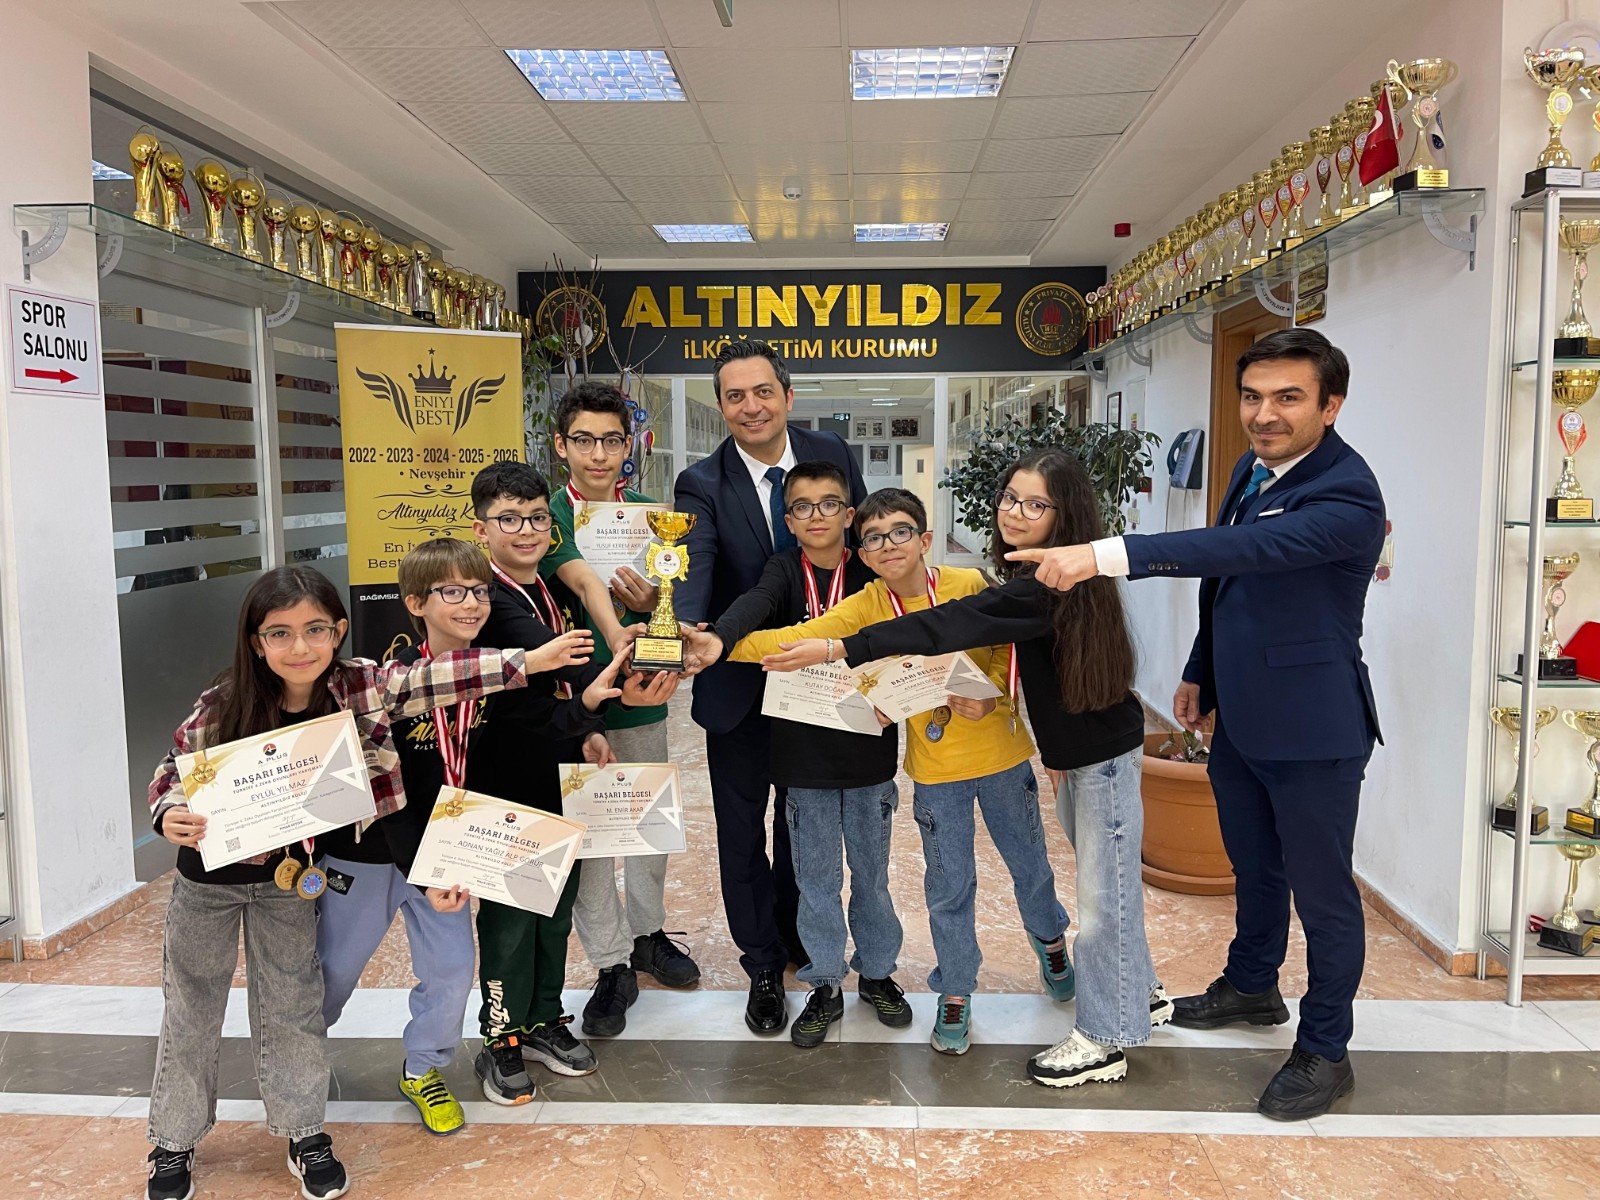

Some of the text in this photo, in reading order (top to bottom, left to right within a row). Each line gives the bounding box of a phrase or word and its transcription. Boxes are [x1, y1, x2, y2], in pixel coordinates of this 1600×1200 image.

[1036, 289, 1069, 300] PRIVATE
[620, 284, 1002, 328] ALTINYILDIZ
[21, 300, 67, 328] SPOR
[23, 332, 88, 362] SALONU
[831, 338, 938, 359] KURUMU
[416, 410, 454, 425] BEST
[349, 447, 376, 463] 2022
[386, 447, 414, 463] 2023
[423, 448, 450, 463] 2024
[459, 448, 485, 463] 2025
[493, 449, 518, 463] 2026
[409, 468, 466, 481] Nevşehir
[377, 502, 457, 524] Altınyıldız
[596, 528, 620, 536] BAŞARI
[384, 542, 404, 553] En
[800, 667, 828, 677] BAŞARI
[890, 673, 917, 685] BAŞARI
[266, 753, 288, 762] PLUS
[233, 769, 274, 787] BAŞARI
[276, 754, 319, 775] BELGESİ
[250, 788, 276, 802] EYLÜL
[593, 790, 651, 800] BAŞARI BELGESİ
[502, 822, 521, 831] PLUS
[468, 825, 541, 849] BAŞARI BELGESİ
[457, 840, 484, 851] ADNAN
[505, 852, 519, 860] ALP
